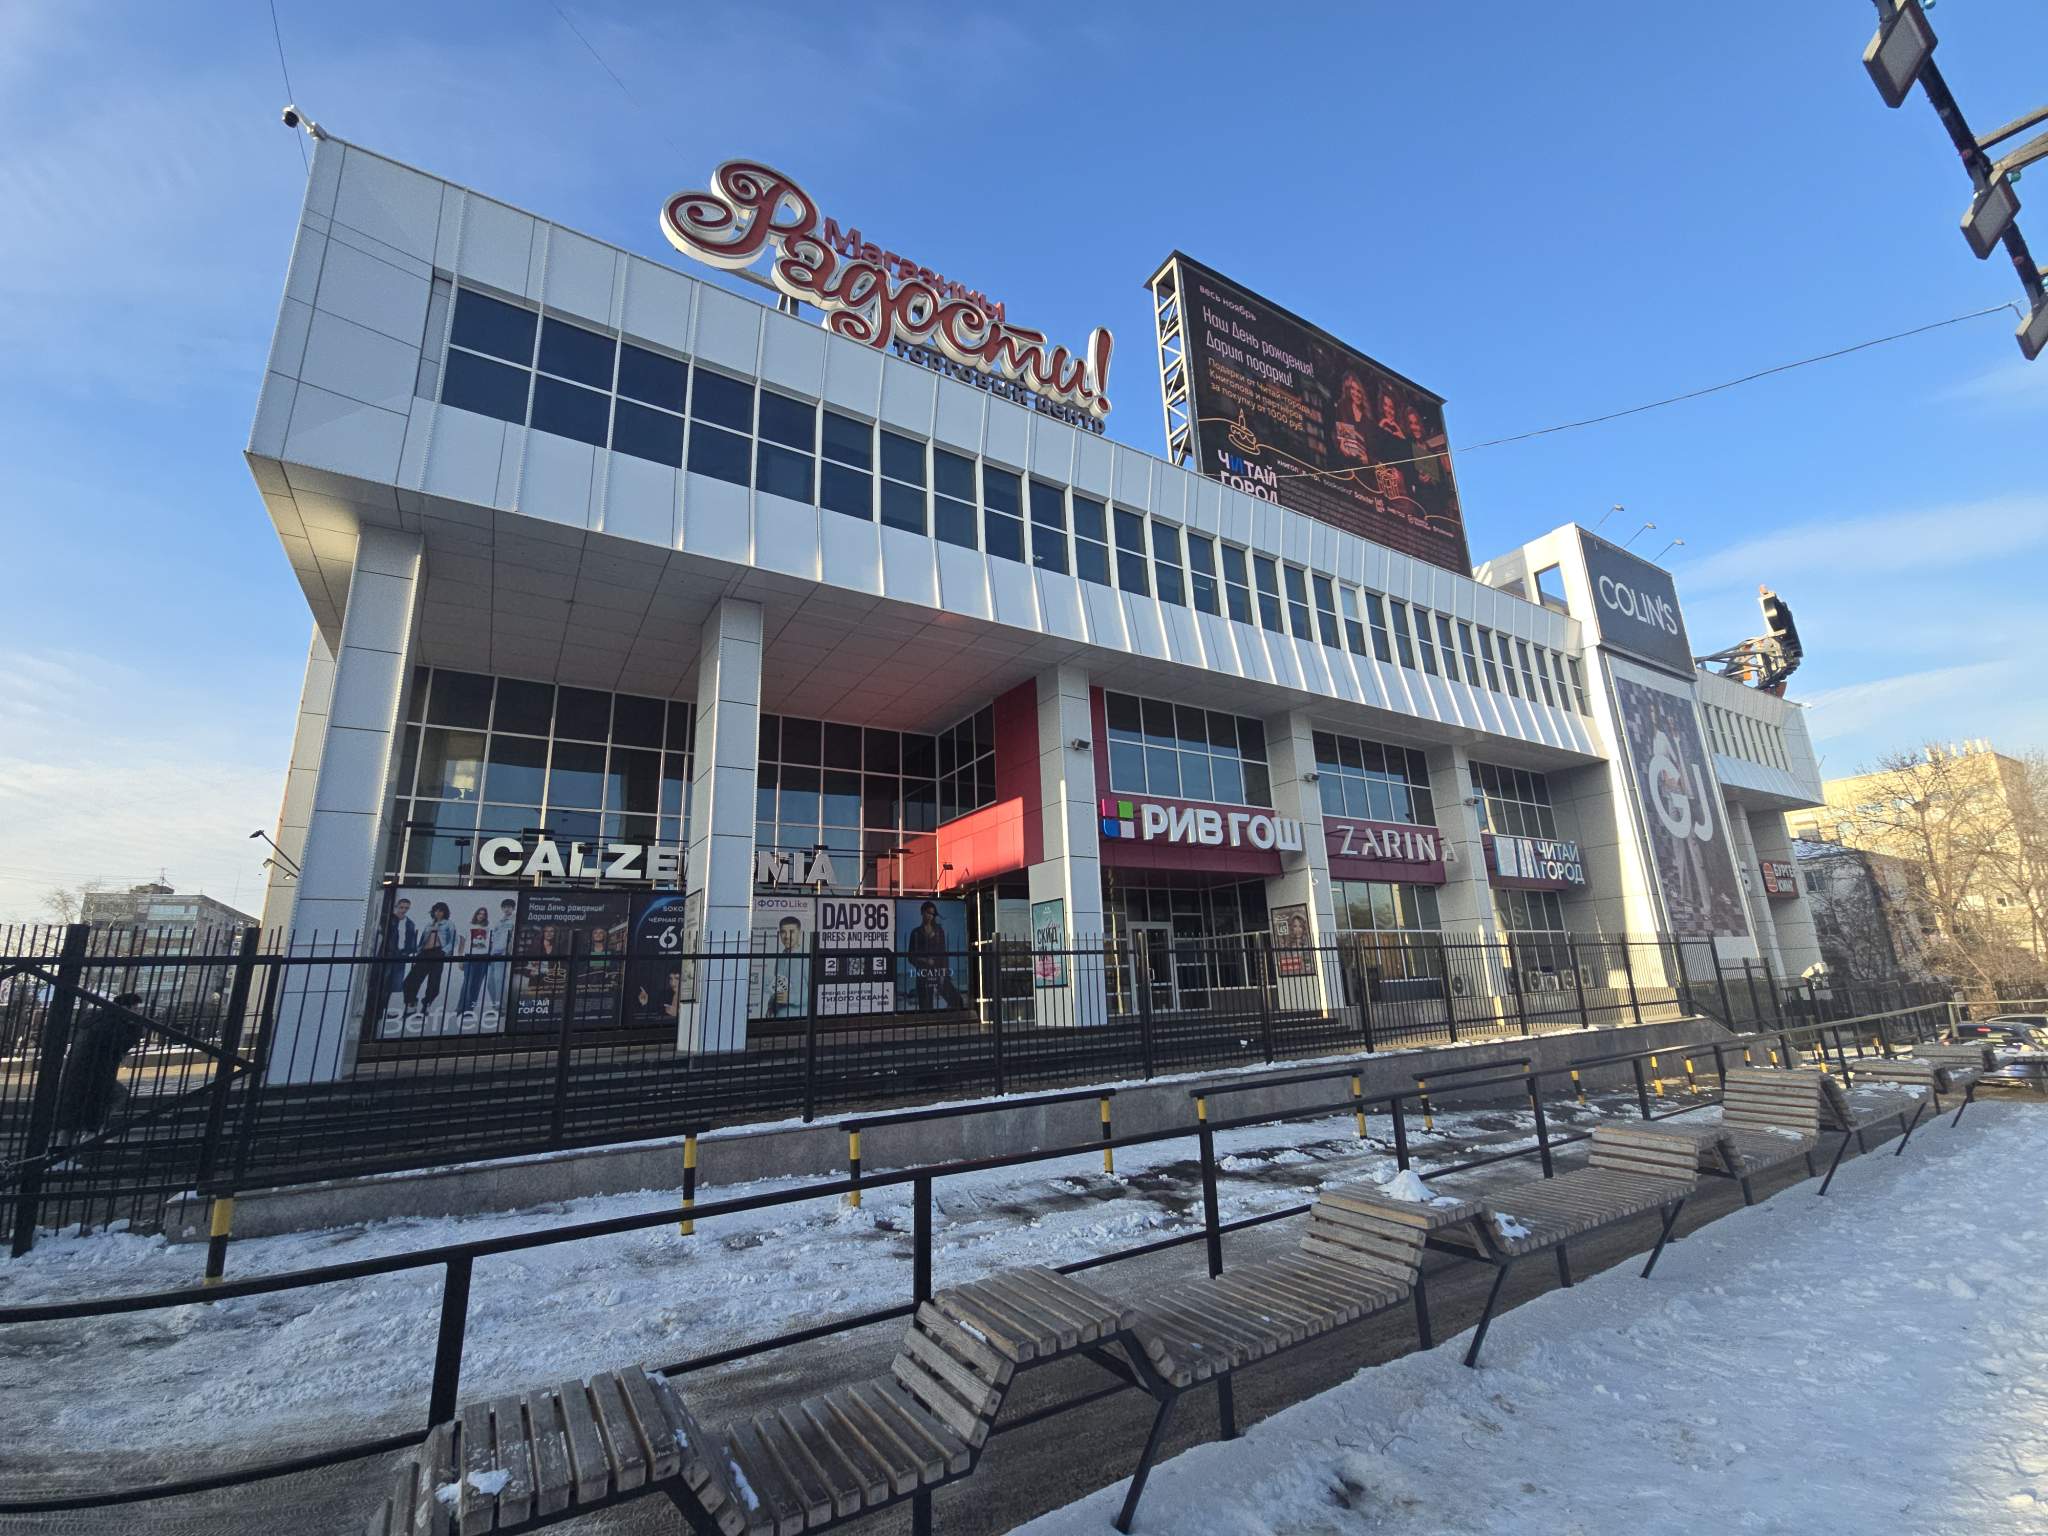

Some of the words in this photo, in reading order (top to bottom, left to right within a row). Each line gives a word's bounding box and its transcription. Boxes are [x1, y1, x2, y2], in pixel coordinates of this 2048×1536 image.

[660, 158, 1114, 420] Радости!
[823, 217, 1006, 322] Магазины
[1223, 299, 1256, 321] ноябрь
[1203, 305, 1229, 333] Наш
[1232, 321, 1259, 349] День
[1262, 341, 1314, 378] рождения!
[1206, 330, 1244, 363] Дарим
[1246, 354, 1294, 388] подарки!
[1034, 393, 1106, 436] центр
[1267, 407, 1288, 424] 1000
[1218, 449, 1278, 489] ЧИТАЙ
[1220, 470, 1279, 505] ГОРОД
[1599, 575, 1678, 636] COLIN'S
[1648, 753, 1714, 843] GJ
[1141, 803, 1223, 846] РИВ
[1228, 812, 1303, 851] ГОШ
[1336, 825, 1459, 864] ZARINA
[479, 837, 838, 885] CALZENIA
[1535, 840, 1580, 864] ЧИТАЙ
[1539, 860, 1586, 886] ГОРОД
[528, 903, 546, 911] Наш
[822, 931, 847, 942] DRESS
[848, 931, 863, 942] AND
[864, 931, 889, 942] PEOPLE
[381, 1007, 500, 1034] Befree
